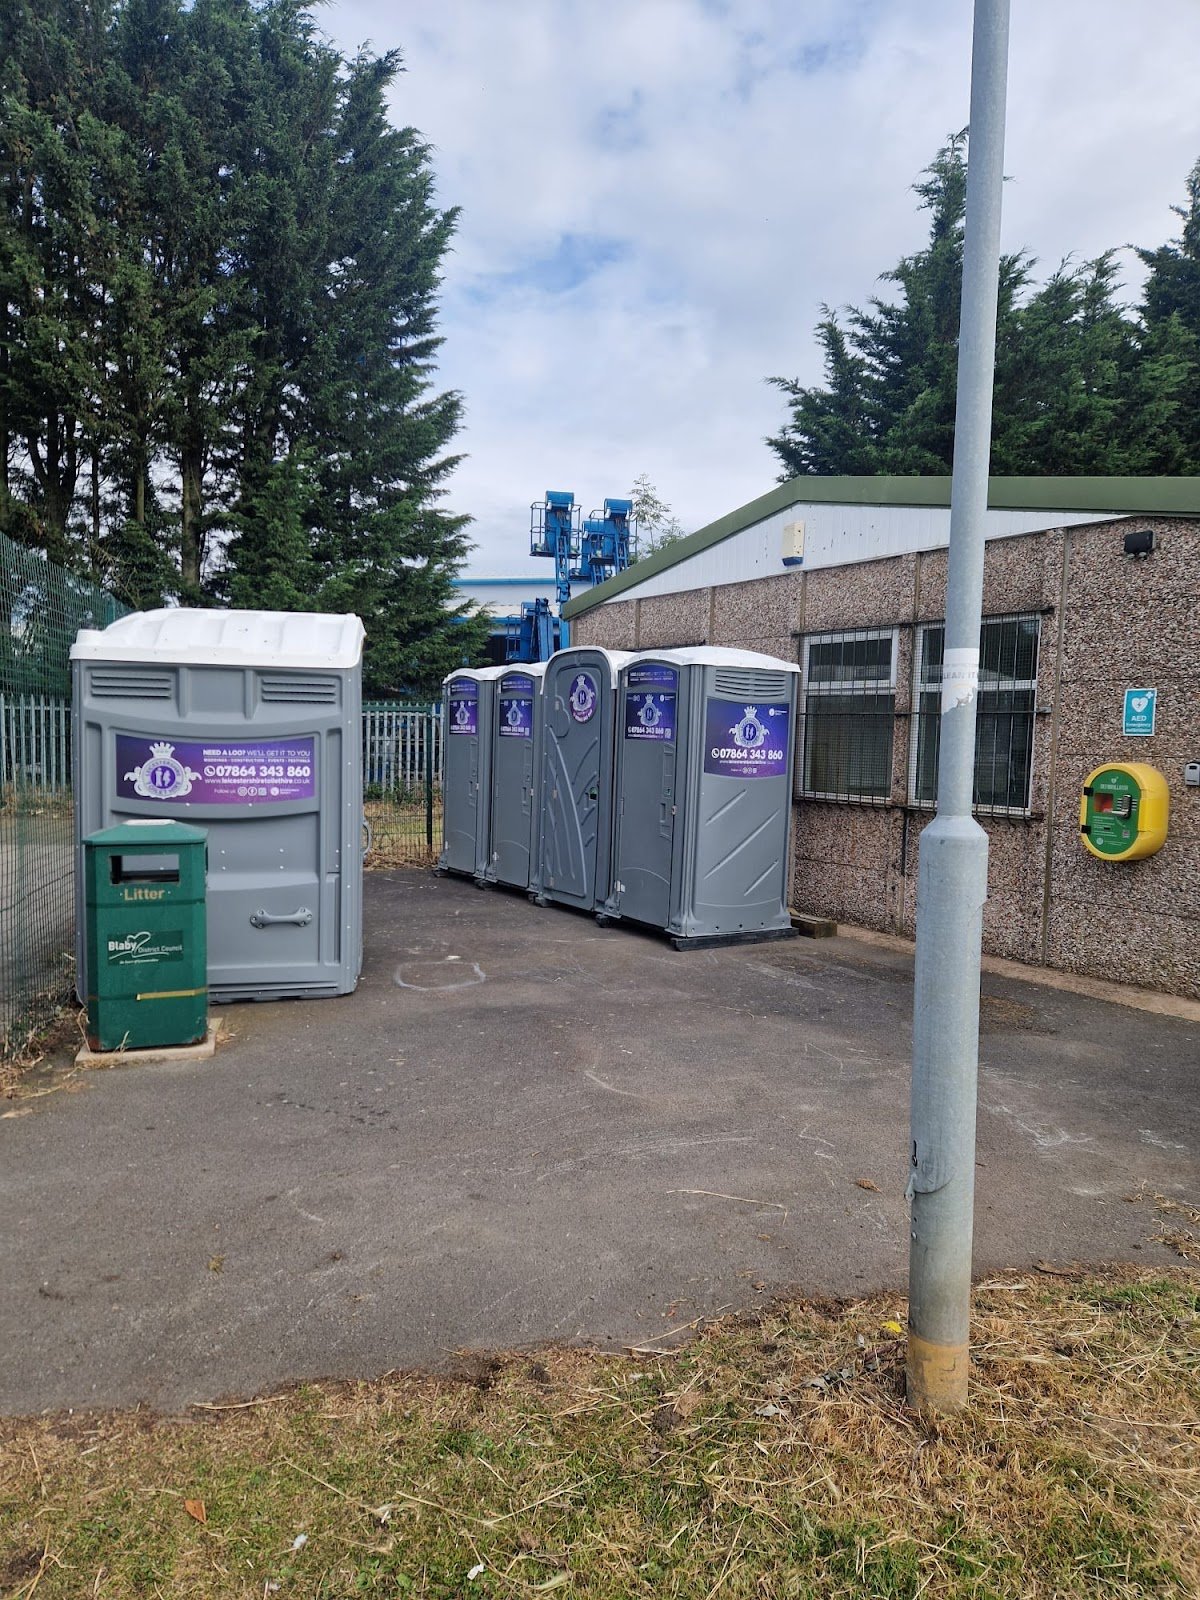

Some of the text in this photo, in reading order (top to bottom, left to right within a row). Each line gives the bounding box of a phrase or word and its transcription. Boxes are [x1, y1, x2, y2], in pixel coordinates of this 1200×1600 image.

[720, 748, 783, 760] 07864 343 860
[216, 765, 311, 777] 07864 343 860
[124, 888, 165, 901] Litter
[108, 940, 183, 954] Blaby District Council
